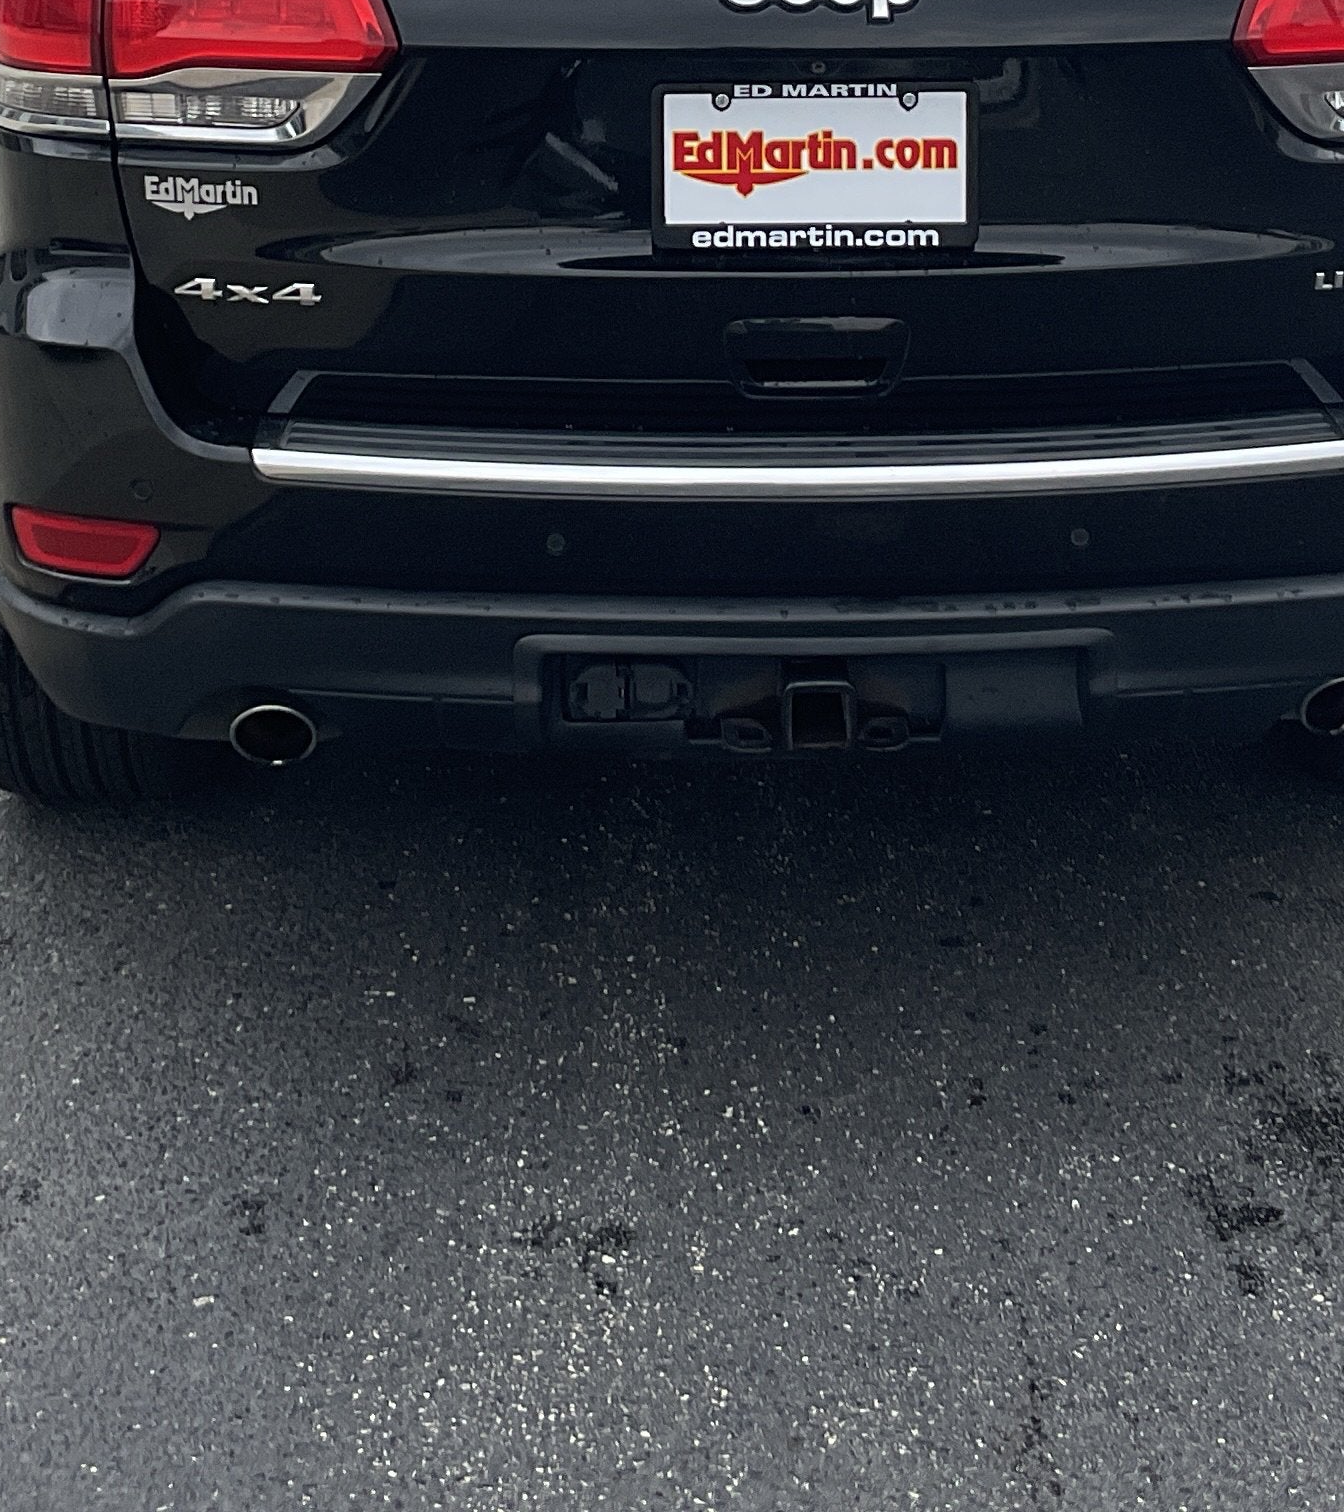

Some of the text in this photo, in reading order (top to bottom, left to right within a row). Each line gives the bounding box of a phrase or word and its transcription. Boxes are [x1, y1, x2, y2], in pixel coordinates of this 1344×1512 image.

[733, 83, 898, 98] ED MARTIN
[671, 128, 959, 174] EdMartin.com
[143, 174, 260, 210] EdMartin
[692, 224, 940, 248] edmartin.com
[173, 276, 323, 307] 4x4
